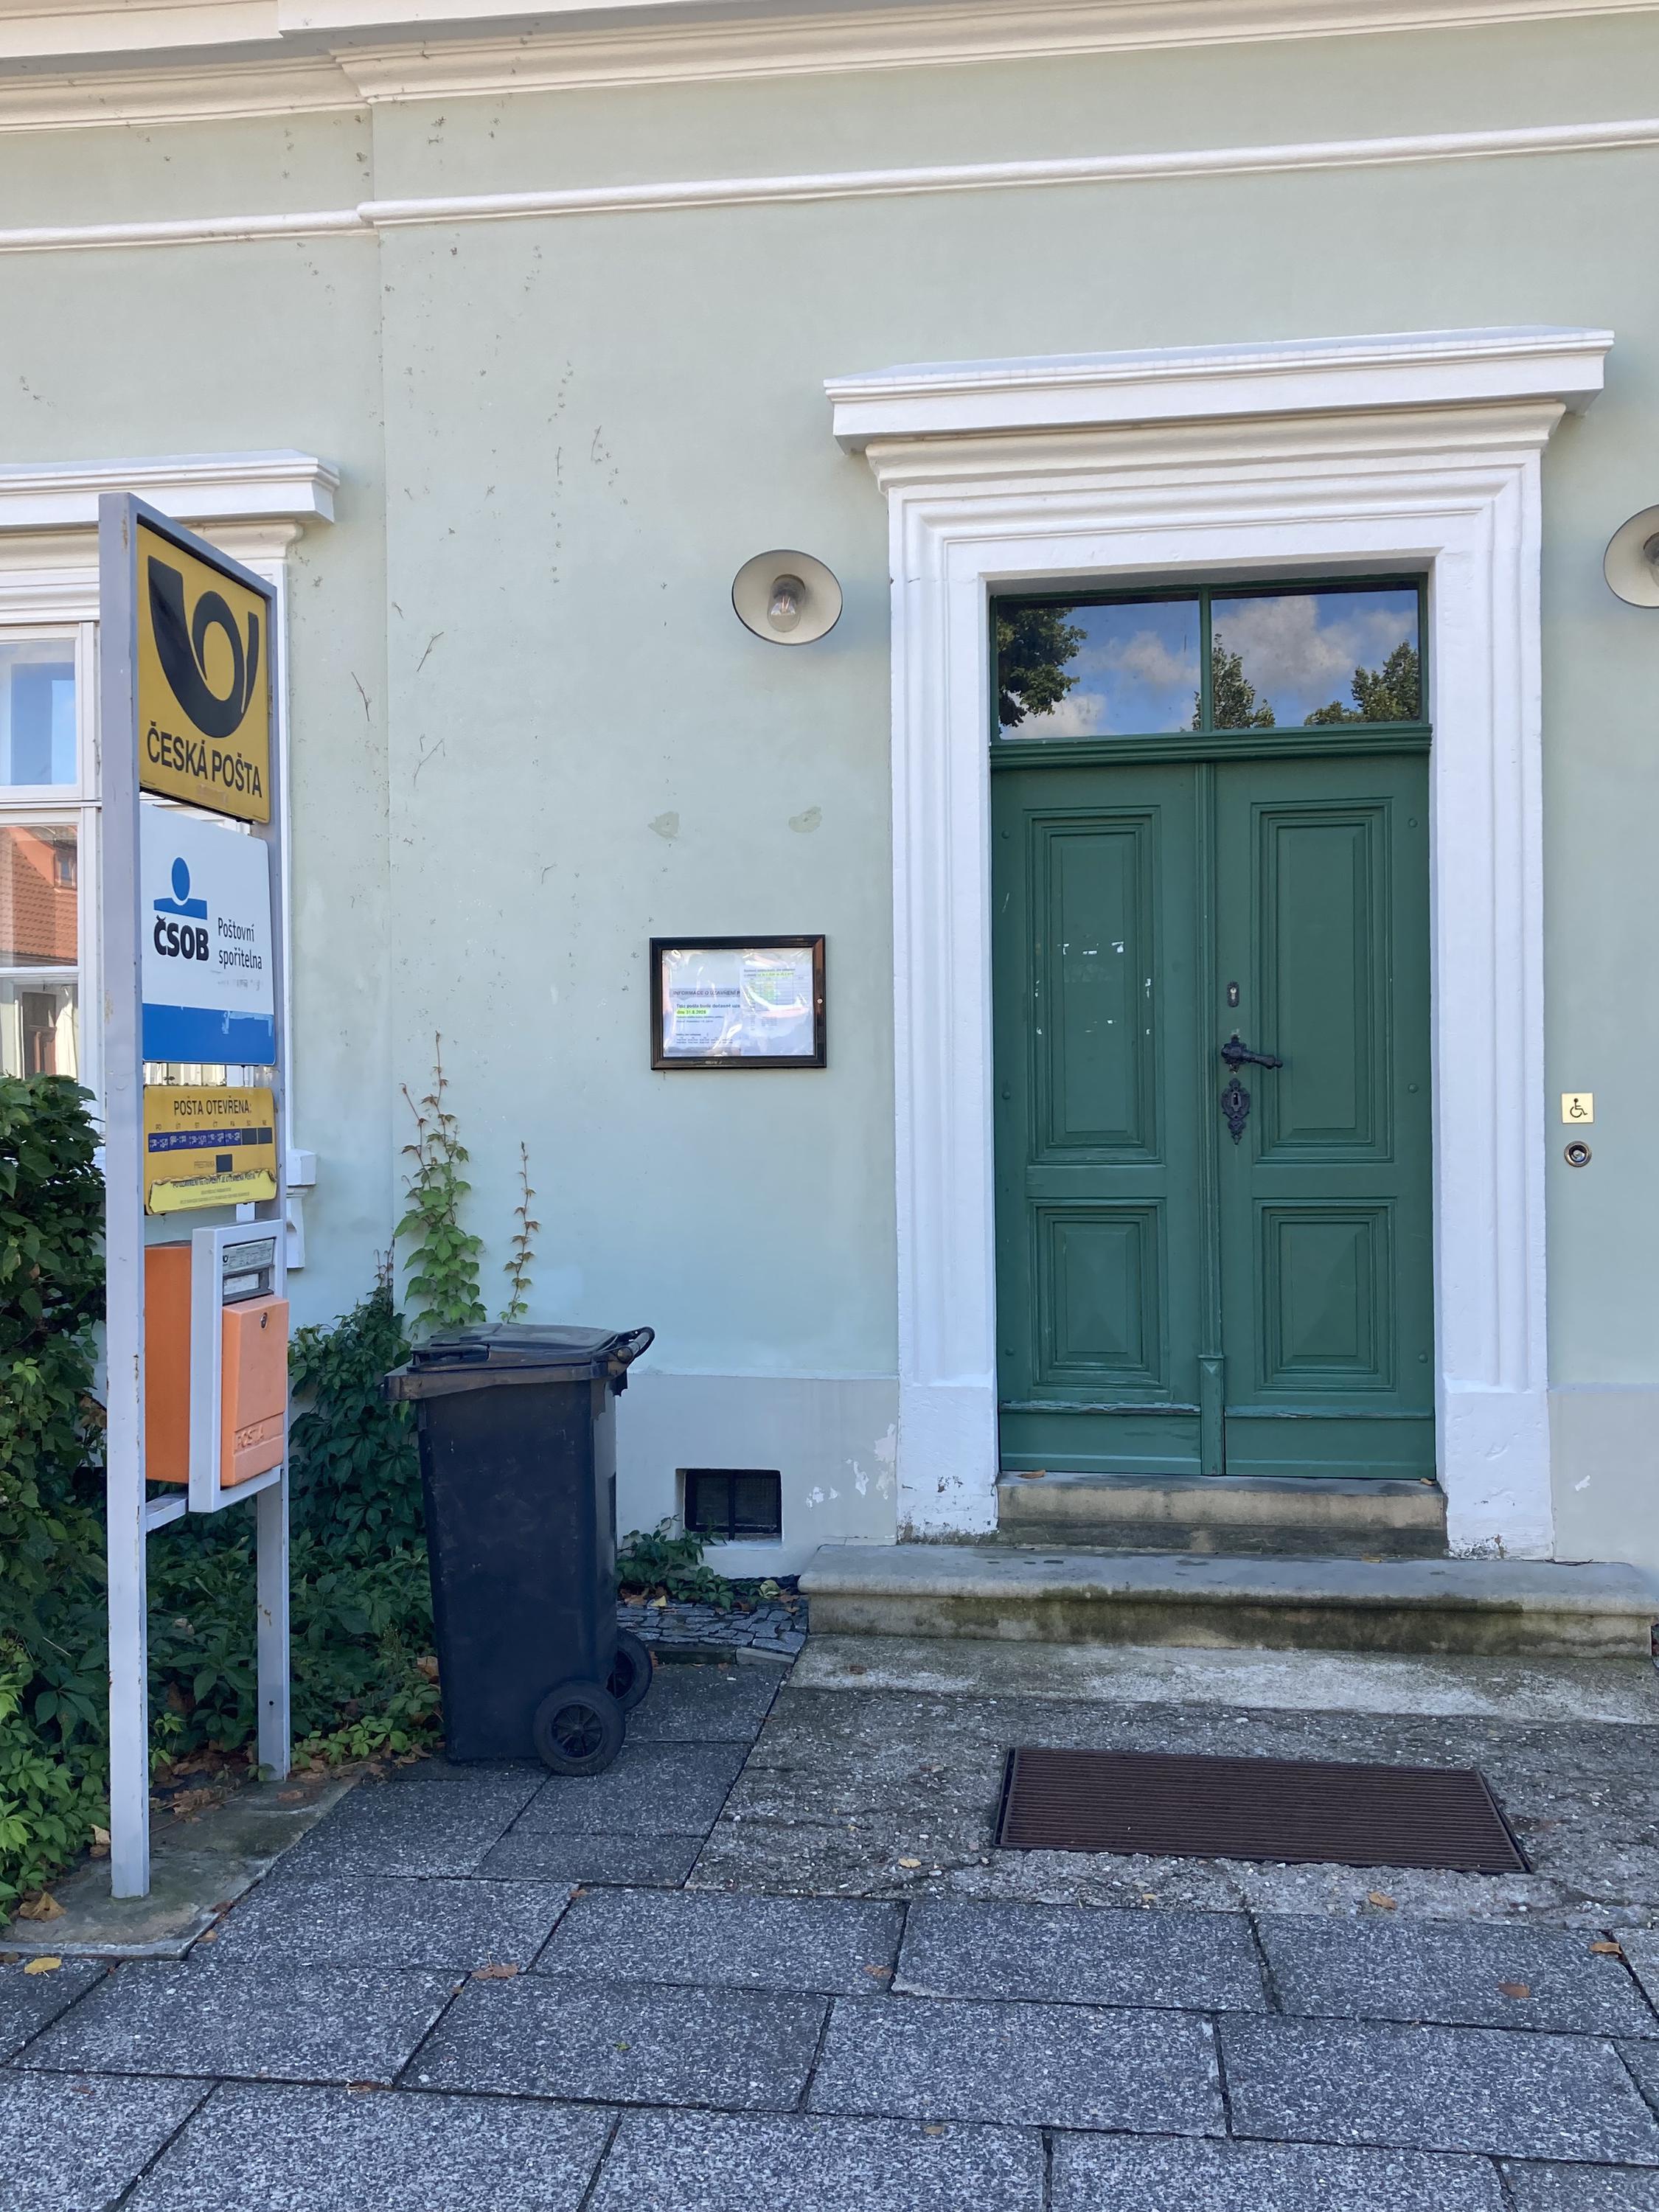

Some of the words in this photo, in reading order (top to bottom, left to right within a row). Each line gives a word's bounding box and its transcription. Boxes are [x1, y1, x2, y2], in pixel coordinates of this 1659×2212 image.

[147, 720, 207, 780] ČESKÁ
[212, 749, 262, 798] POŠTA
[153, 914, 209, 961] ČSOB
[218, 917, 255, 943] Poštovní
[218, 948, 262, 970] spořitelna
[174, 1096, 204, 1116] POŠTA
[206, 1095, 252, 1115] OTEVŘENA:
